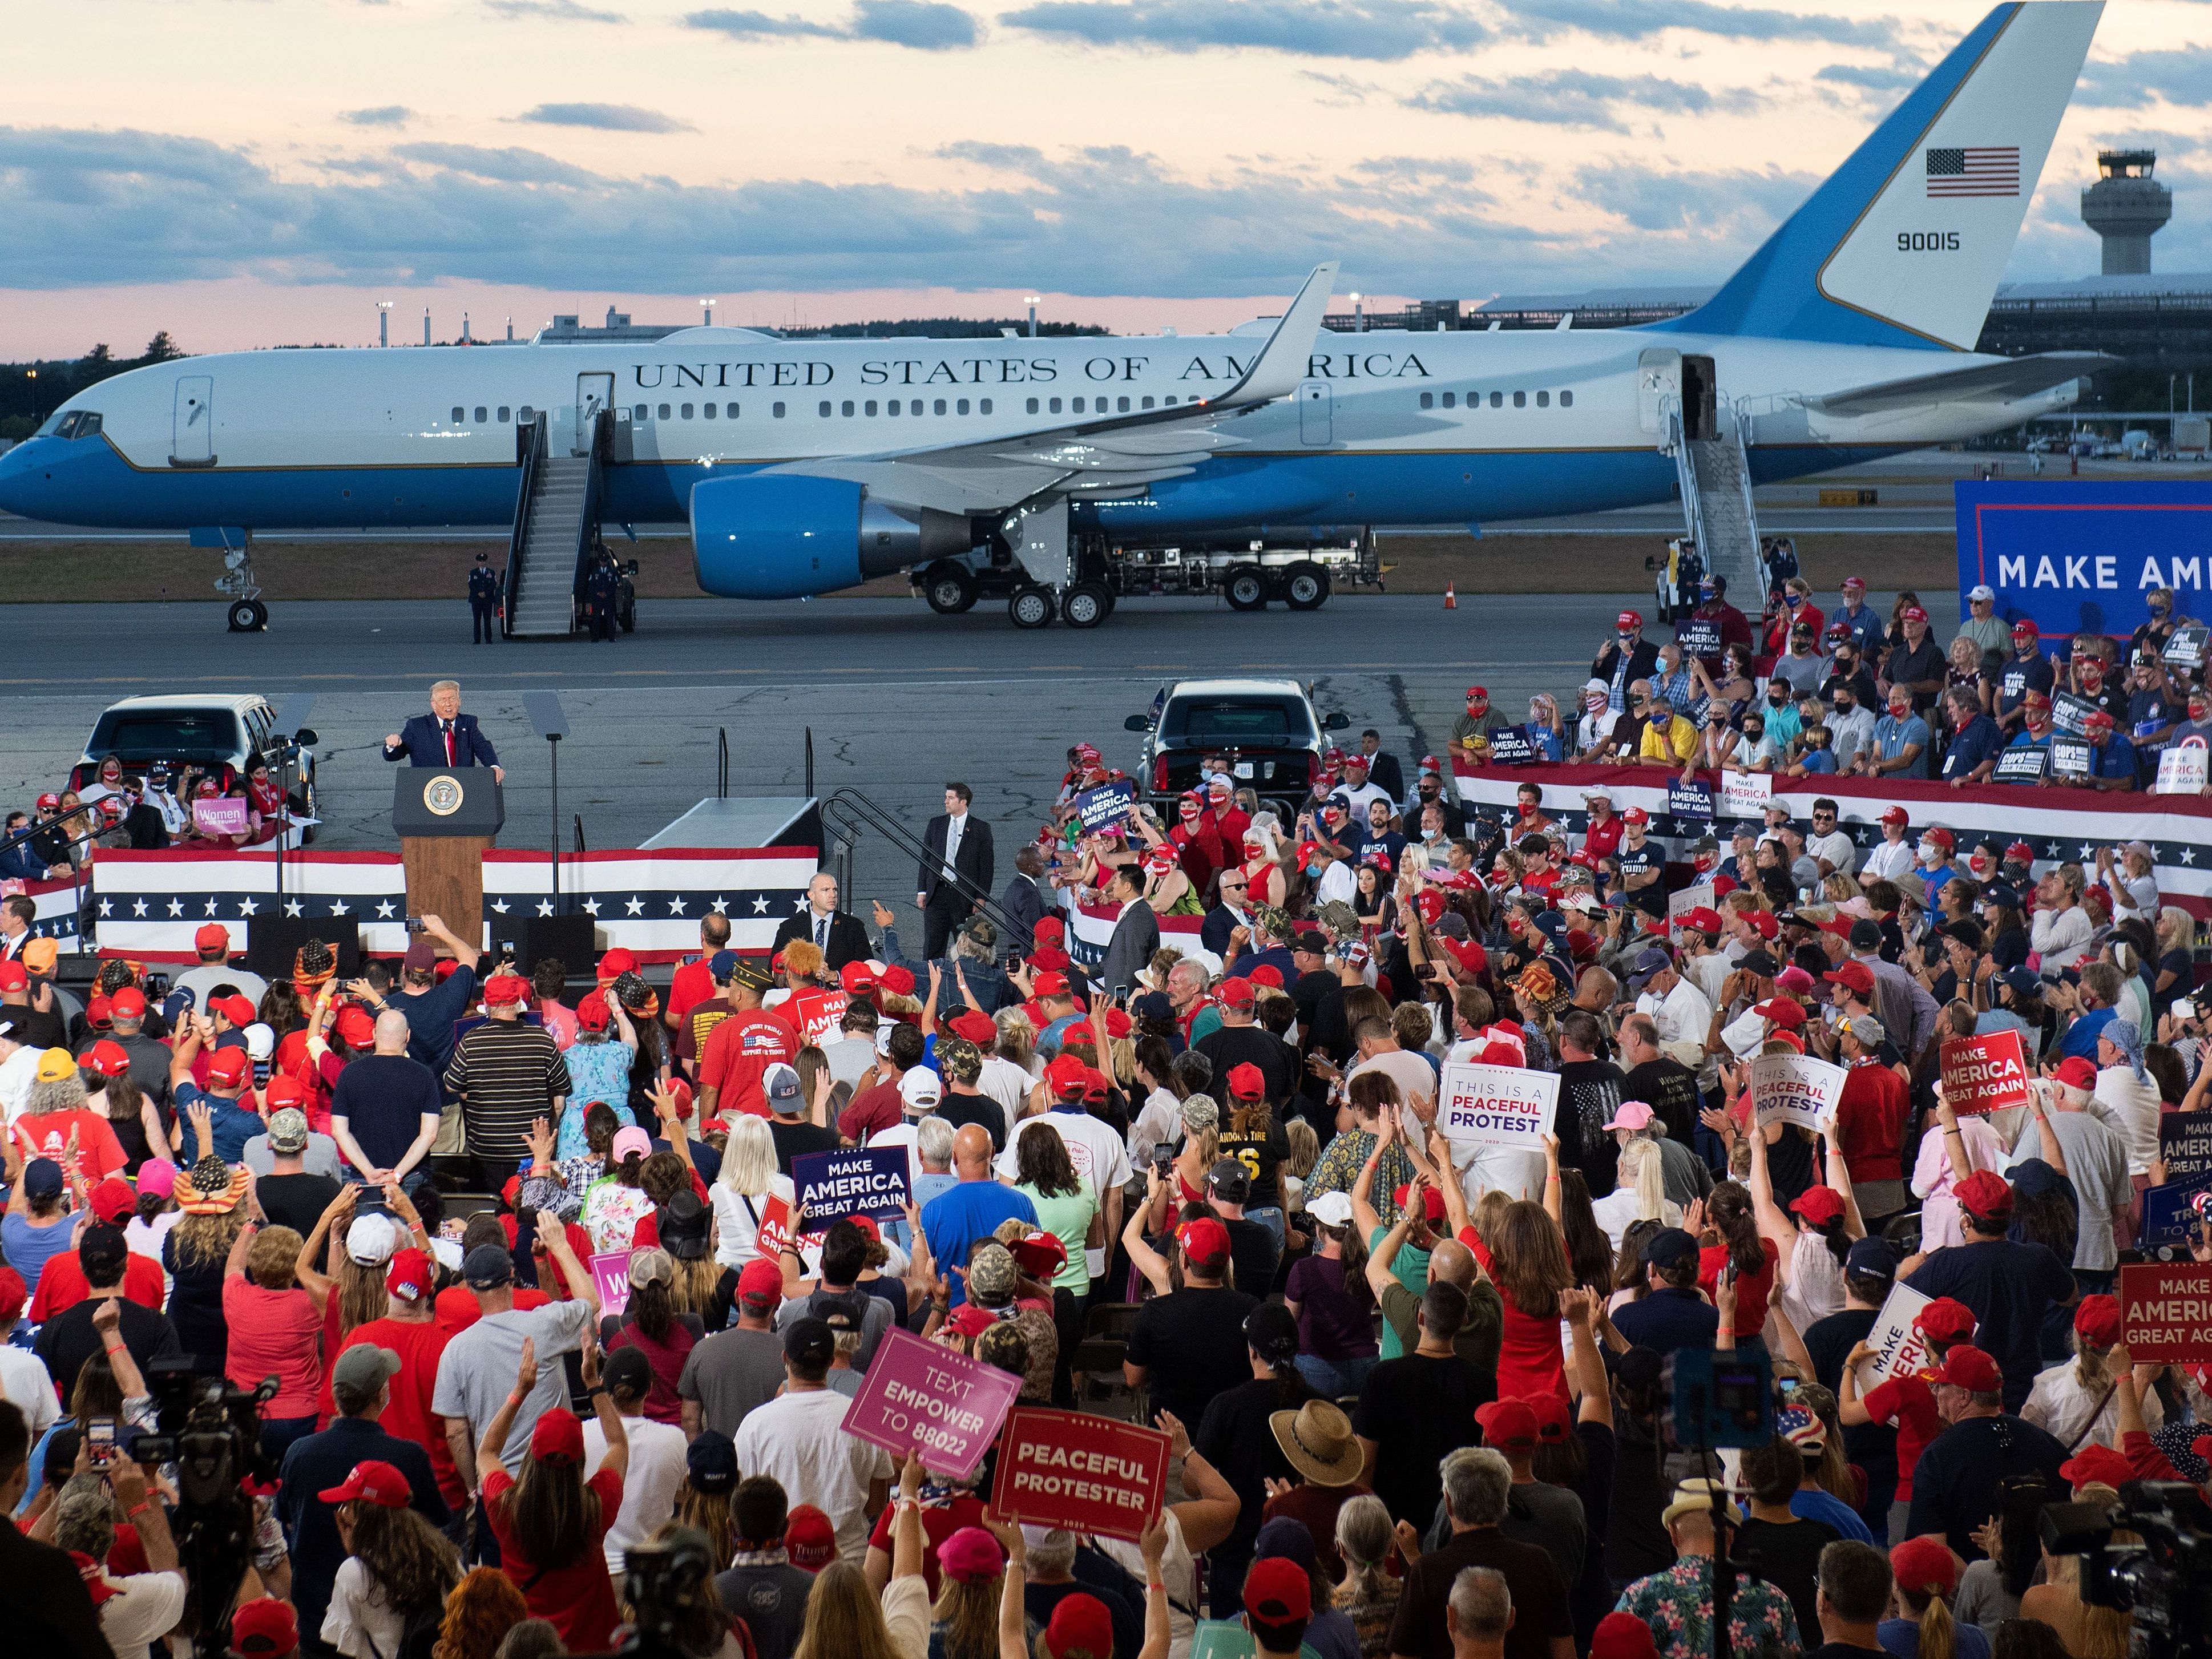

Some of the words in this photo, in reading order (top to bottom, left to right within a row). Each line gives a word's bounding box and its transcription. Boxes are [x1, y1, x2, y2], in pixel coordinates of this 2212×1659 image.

[1898, 232, 1960, 251] 90015
[632, 361, 835, 389] UNITED
[860, 358, 1058, 385] STATES
[1084, 356, 1149, 381] OF
[1177, 353, 1433, 381] AMRICA
[1999, 555, 2118, 590] MAKE
[2138, 555, 2212, 591] AM
[1679, 633, 1720, 645] AMERICA
[2054, 700, 2078, 720] COPS
[1491, 740, 1529, 750] AMERICA
[2054, 744, 2076, 760] COPS
[2001, 753, 2027, 764] COPS
[1092, 789, 1115, 803] MAKE
[1671, 791, 1710, 804] AMERICA
[1725, 787, 1768, 800] AMERICA
[200, 809, 241, 821] Women
[1081, 794, 1131, 819] AMERICA
[1083, 811, 1106, 827] GREAT
[1107, 803, 1131, 819] AGAIN
[1671, 801, 1690, 811] GREAT
[1692, 804, 1712, 813] AGAIN
[1361, 843, 1388, 854] NASA
[1673, 902, 1686, 911] THIS
[822, 1000, 846, 1012] MAK
[740, 1027, 750, 1037] RED
[764, 1024, 784, 1036] FRIDAY
[1952, 1047, 1987, 1064] MAKE
[1758, 1069, 1786, 1083] THIS
[1796, 1070, 1809, 1081] IS
[1819, 1077, 1829, 1088] A
[1942, 1058, 2021, 1087] AMERICA
[1455, 1080, 1495, 1094] THIS
[1505, 1084, 1521, 1097] IS
[1532, 1089, 1543, 1100] A
[1757, 1080, 1826, 1100] PEACEFUL
[1977, 1077, 2025, 1097] AGAIN
[1452, 1095, 1542, 1116] PEACEFUL
[1757, 1095, 1824, 1115] PROTEST
[1450, 1112, 1540, 1133] PROTEST
[1251, 1131, 1266, 1142] TIRE
[828, 1160, 873, 1177] MAKE
[2168, 1160, 2201, 1173] GREAT
[801, 1173, 905, 1204] AMERICA
[802, 1201, 853, 1220] GREAT
[857, 1192, 906, 1212] AGAIN
[2161, 1225, 2183, 1236] TO
[2159, 1279, 2210, 1295] MAKE
[2126, 1328, 2185, 1345] GREAT
[1872, 1325, 1904, 1373] MAKE
[926, 1365, 975, 1400] TEXT
[883, 1379, 984, 1435] EMPOWER
[881, 1406, 909, 1432] TO
[912, 1422, 968, 1458] 88022
[1018, 1441, 1150, 1484] PEACEFUL
[1013, 1471, 1146, 1512] PROTESTER
[1063, 1519, 1085, 1529] 2020
[796, 1543, 829, 1555] Trump
